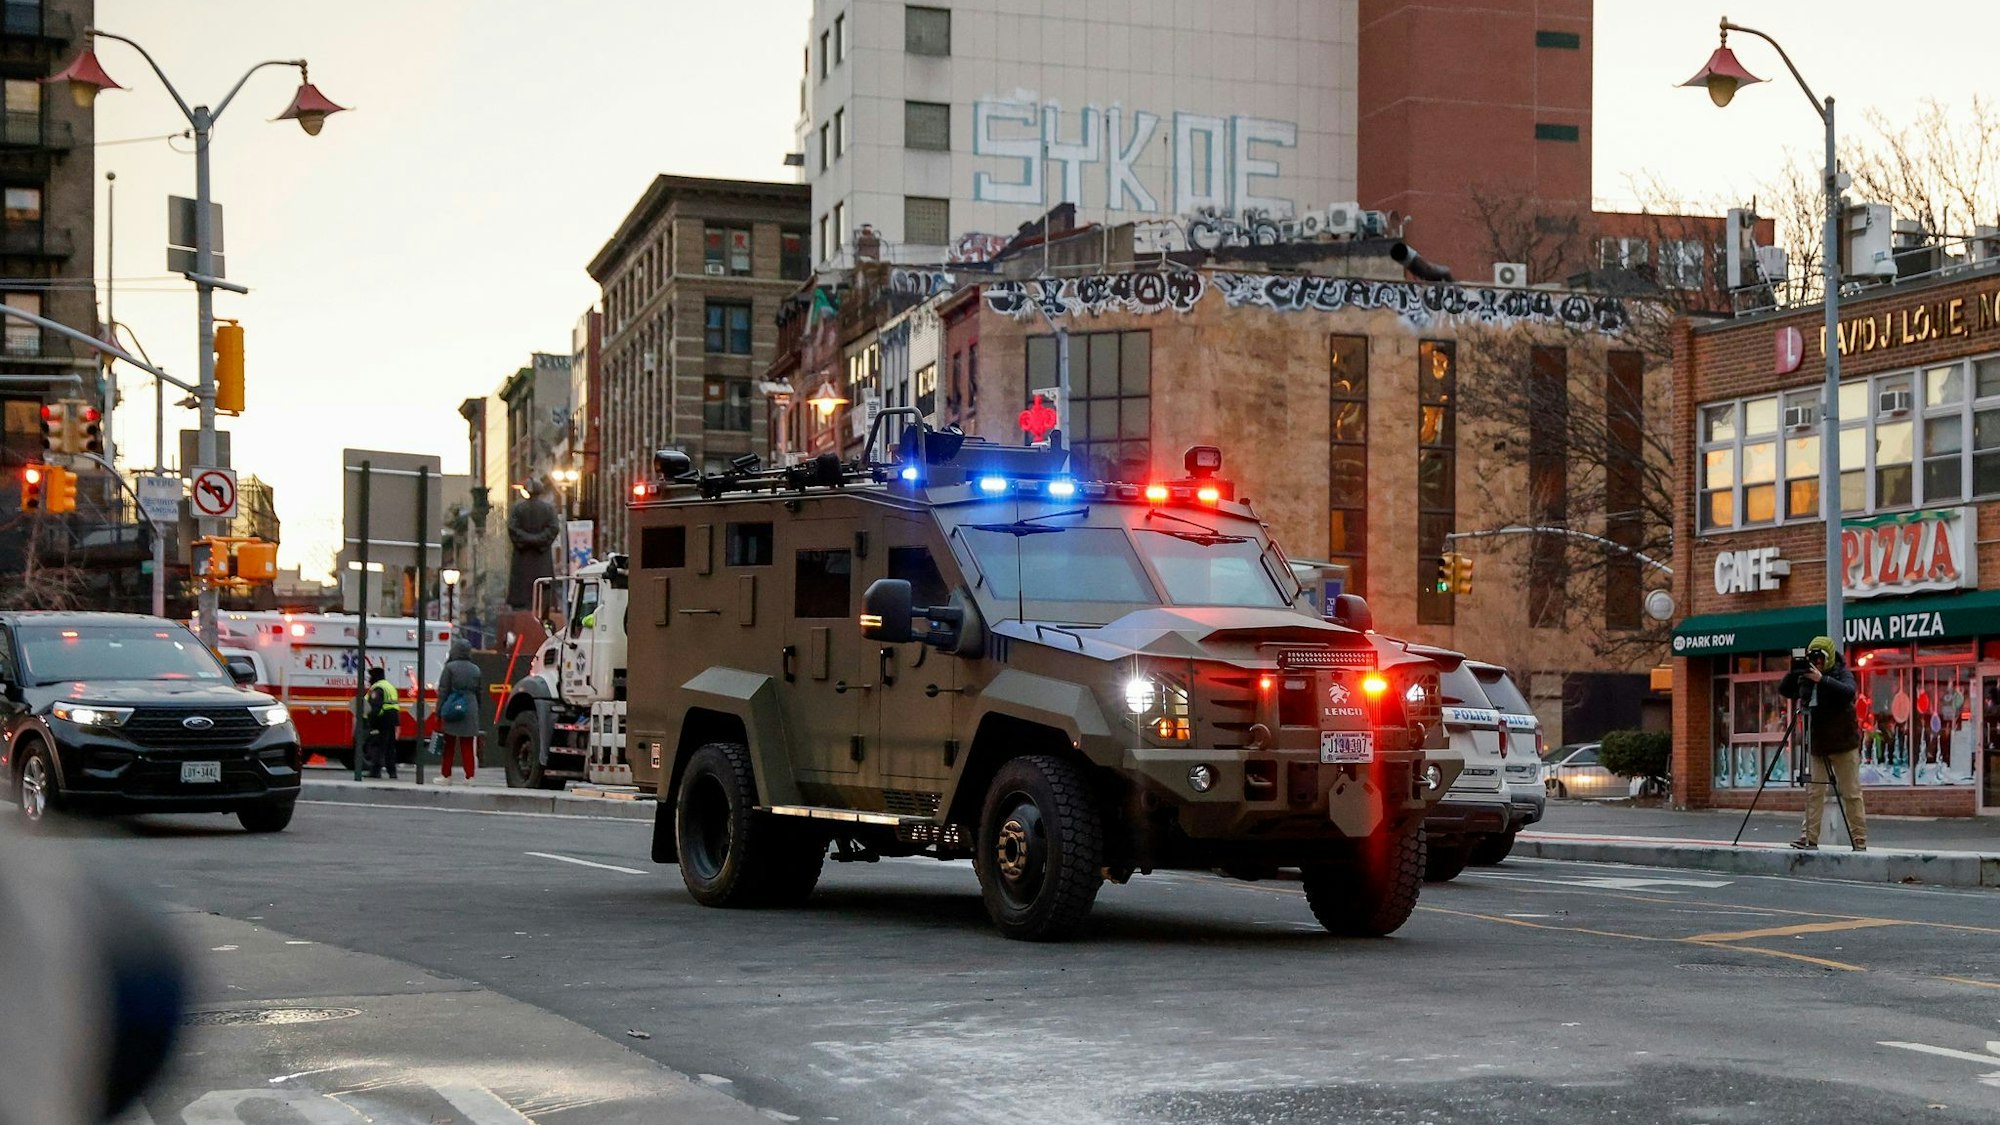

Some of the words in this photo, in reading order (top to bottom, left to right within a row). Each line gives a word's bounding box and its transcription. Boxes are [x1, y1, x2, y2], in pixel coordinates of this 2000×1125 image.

[1842, 520, 1960, 588] PIZZA
[1714, 547, 1780, 595] CAFE
[1889, 611, 1945, 640] PIZZA
[1686, 635, 1711, 649] PARK
[1712, 633, 1736, 647] ROW
[1324, 707, 1363, 716] LENCO
[1452, 708, 1493, 722] POLICE
